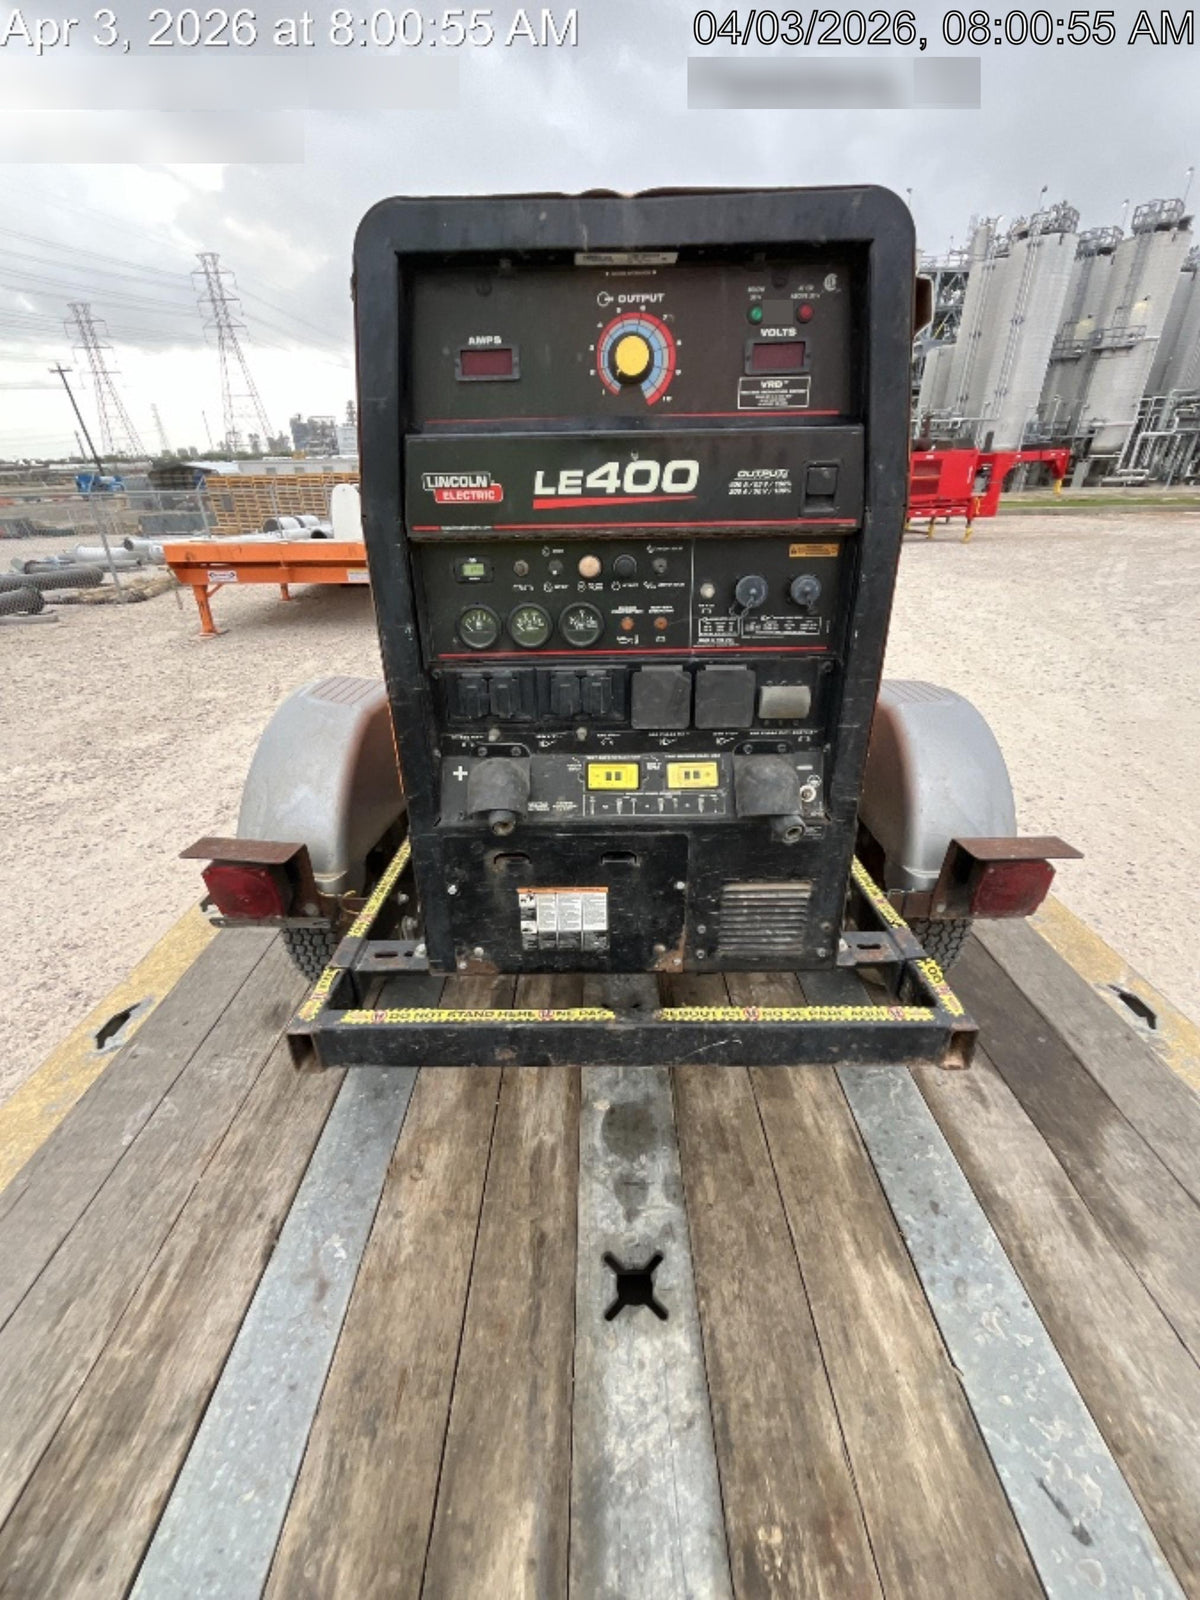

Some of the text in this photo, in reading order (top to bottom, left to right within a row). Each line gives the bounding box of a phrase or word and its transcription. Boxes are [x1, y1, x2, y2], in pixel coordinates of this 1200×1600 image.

[617, 292, 666, 304] OUTPUT
[760, 327, 798, 338] VOLTS
[467, 335, 503, 346] AMPS
[425, 474, 488, 489] LINCOLN
[533, 459, 699, 496] LE400
[441, 489, 497, 501] ELECTRIC
[414, 1011, 445, 1019] NOT
[446, 1010, 495, 1018] STAND
